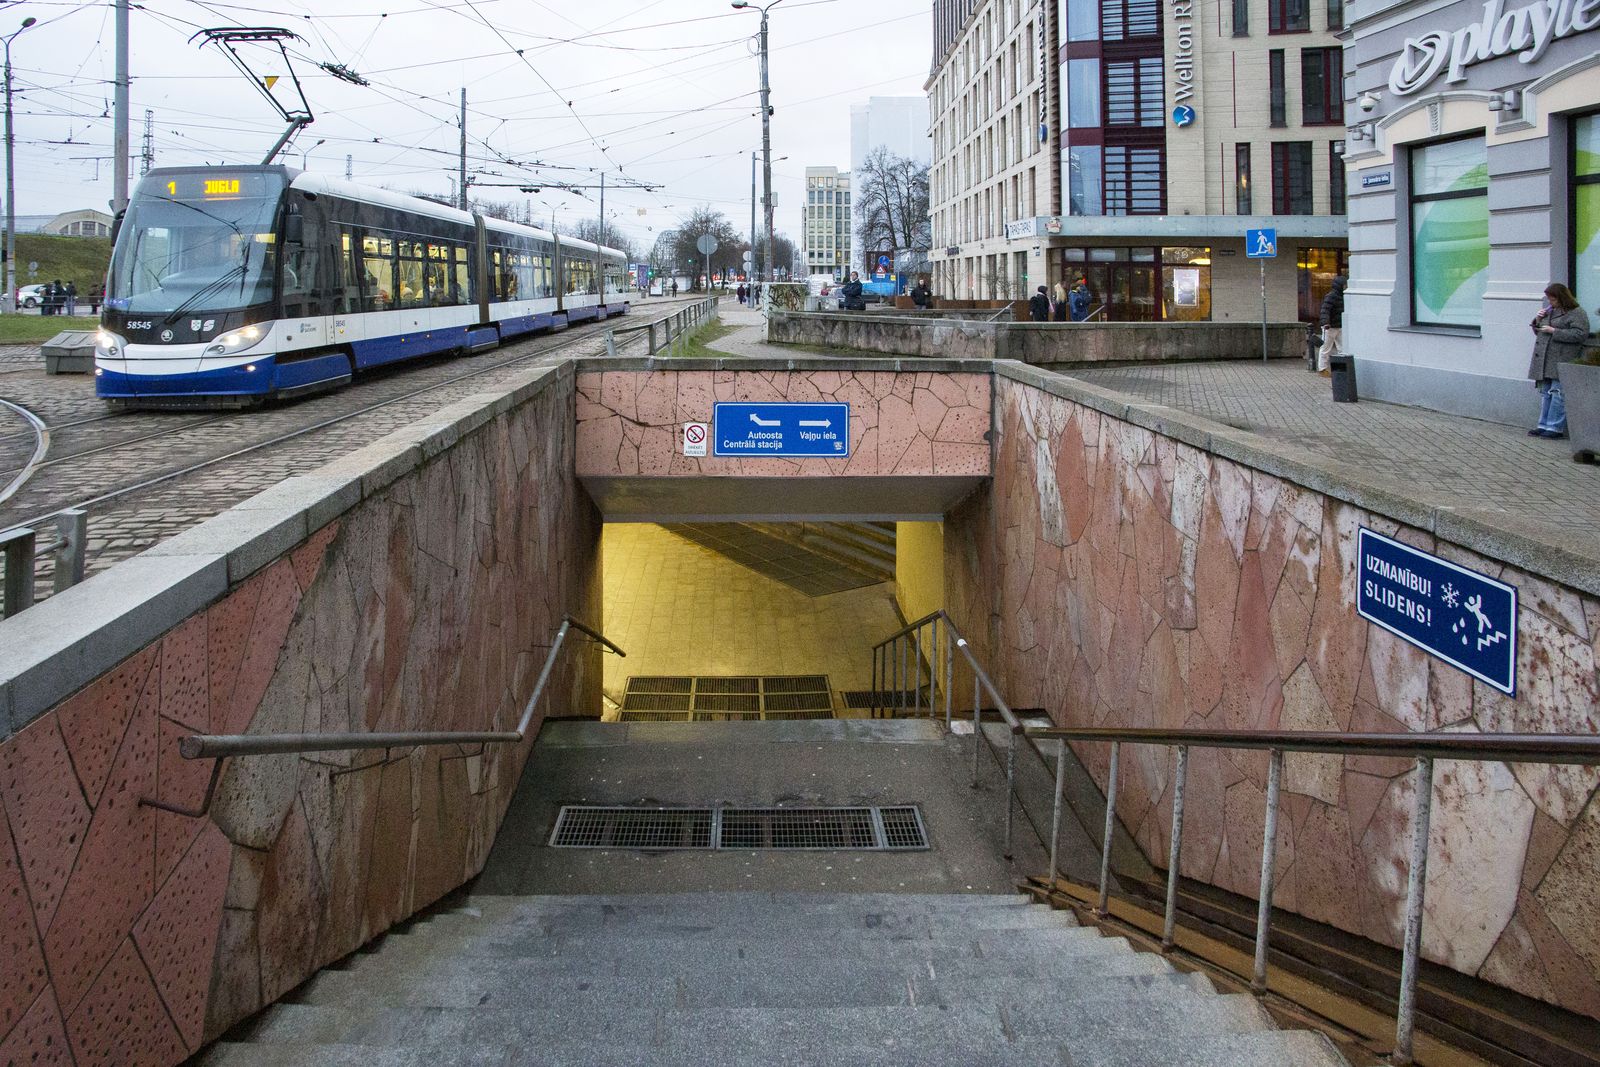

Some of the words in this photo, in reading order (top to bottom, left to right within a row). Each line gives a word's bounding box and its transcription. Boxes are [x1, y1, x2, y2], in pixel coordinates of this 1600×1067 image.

[1175, 23, 1193, 103] Wellton
[167, 181, 176, 195] 1
[204, 180, 240, 194] JUGLA
[126, 320, 152, 330] 58545
[748, 431, 783, 440] Autoosta
[800, 432, 821, 441] Vaļņu
[823, 431, 837, 440] iela
[723, 440, 756, 448] Centrālā
[757, 440, 783, 450] stacija
[1366, 554, 1432, 598] UZMANĪBU!
[1365, 580, 1432, 627] SLIDENS!
